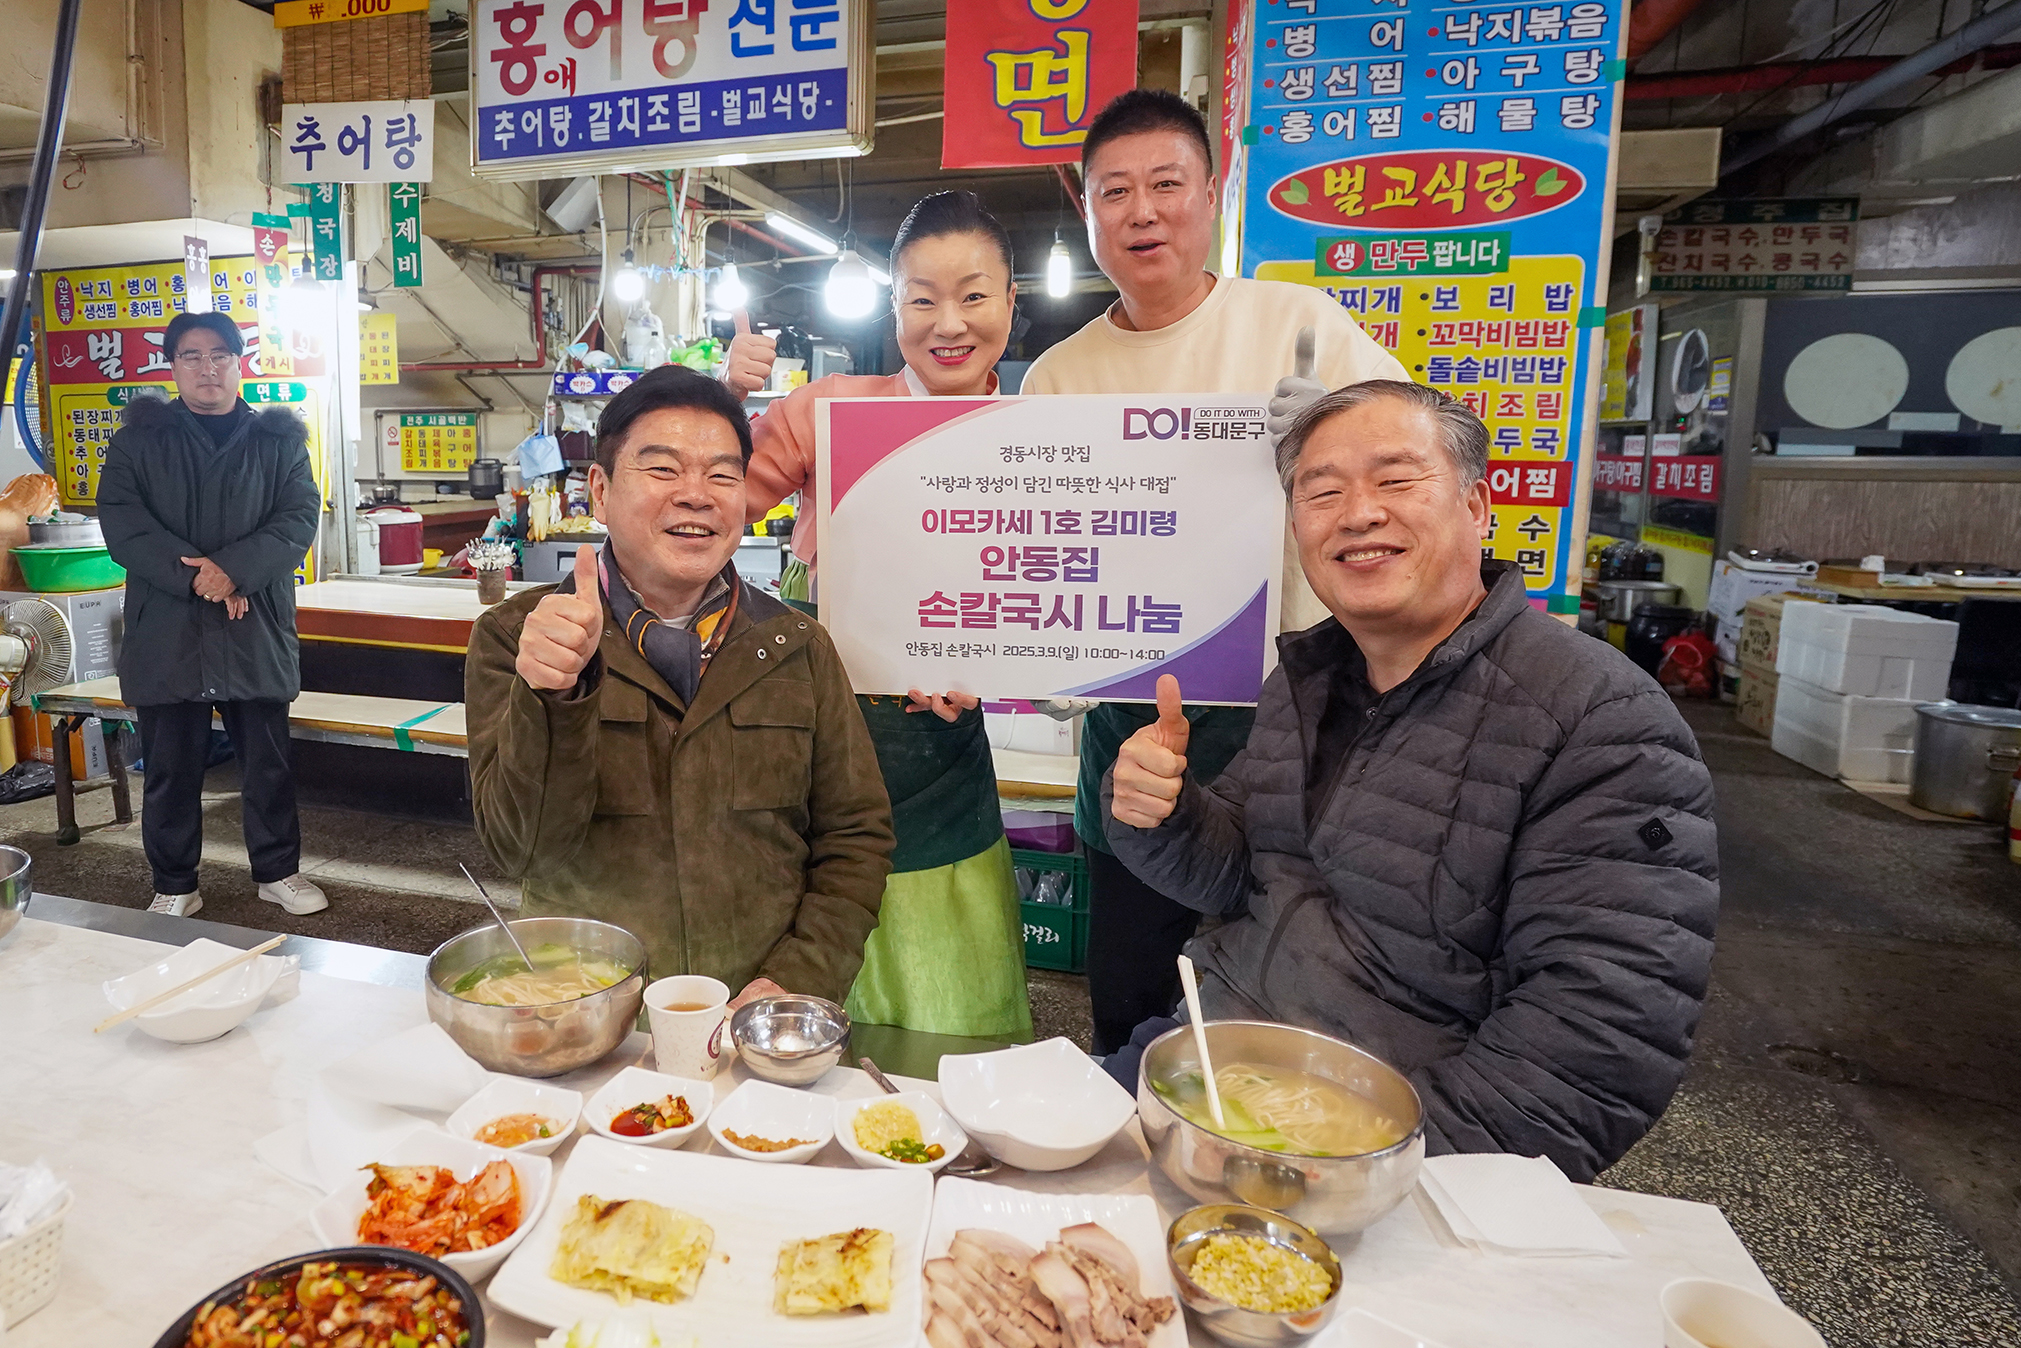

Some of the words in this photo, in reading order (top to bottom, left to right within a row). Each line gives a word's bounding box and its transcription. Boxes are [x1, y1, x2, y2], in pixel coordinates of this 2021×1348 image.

[1444, 3, 1607, 46] 낙지볶음
[544, 57, 577, 97] 애
[1280, 61, 1402, 100] 생선찜
[1442, 49, 1604, 89] 아구탕
[1278, 105, 1402, 144] 홍어찜
[1438, 95, 1600, 133] 해물탕
[289, 113, 422, 172] 추어탕
[1324, 157, 1525, 217] 벌교식당
[392, 184, 418, 279] 수제비
[1370, 240, 1428, 269] 만두
[1433, 239, 1500, 266] 팝니다
[57, 279, 72, 322] 안주류
[80, 280, 112, 299] 낙지
[127, 277, 158, 296] 병어
[1322, 286, 1402, 314] 찌개
[84, 303, 117, 320] 생선찜
[129, 299, 163, 319] 홍어찜
[1429, 320, 1570, 348] 꼬막비빔밥
[1427, 356, 1566, 384] 돌솥비빔밥
[257, 383, 291, 400] 면류
[1446, 391, 1562, 420] 치조림
[1123, 407, 1190, 440] DO!
[1200, 409, 1211, 418] DO
[1214, 409, 1221, 418] IT
[1224, 409, 1235, 418] DO
[1237, 409, 1260, 418] WITH
[1193, 421, 1266, 440] 동대문구
[1494, 428, 1560, 455] 두국
[447, 428, 456, 468] 아구탕
[999, 445, 1057, 463] 경동시장
[1061, 445, 1091, 463] 맛집
[920, 474, 972, 492] "사랑과
[975, 475, 1018, 492] 정성이
[1023, 475, 1052, 492] 담긴
[1056, 475, 1101, 493] 따뜻한
[1105, 475, 1136, 493] 식사
[1140, 475, 1177, 494] 대접"
[1490, 466, 1557, 499] 어찜
[1656, 463, 1714, 493] 갈치조림
[922, 509, 1033, 535] 이모카세
[1040, 510, 1082, 535] 1호
[1091, 510, 1177, 537] 김미령
[979, 545, 1100, 583] 안동집
[917, 590, 1083, 631] 손칼국시
[1099, 595, 1182, 634] 나눔
[905, 642, 944, 658] 안동집
[946, 643, 996, 658] 손칼국시
[1002, 645, 1079, 661] 2025.3.9.(일)
[1084, 647, 1165, 661] 10:00~14:00
